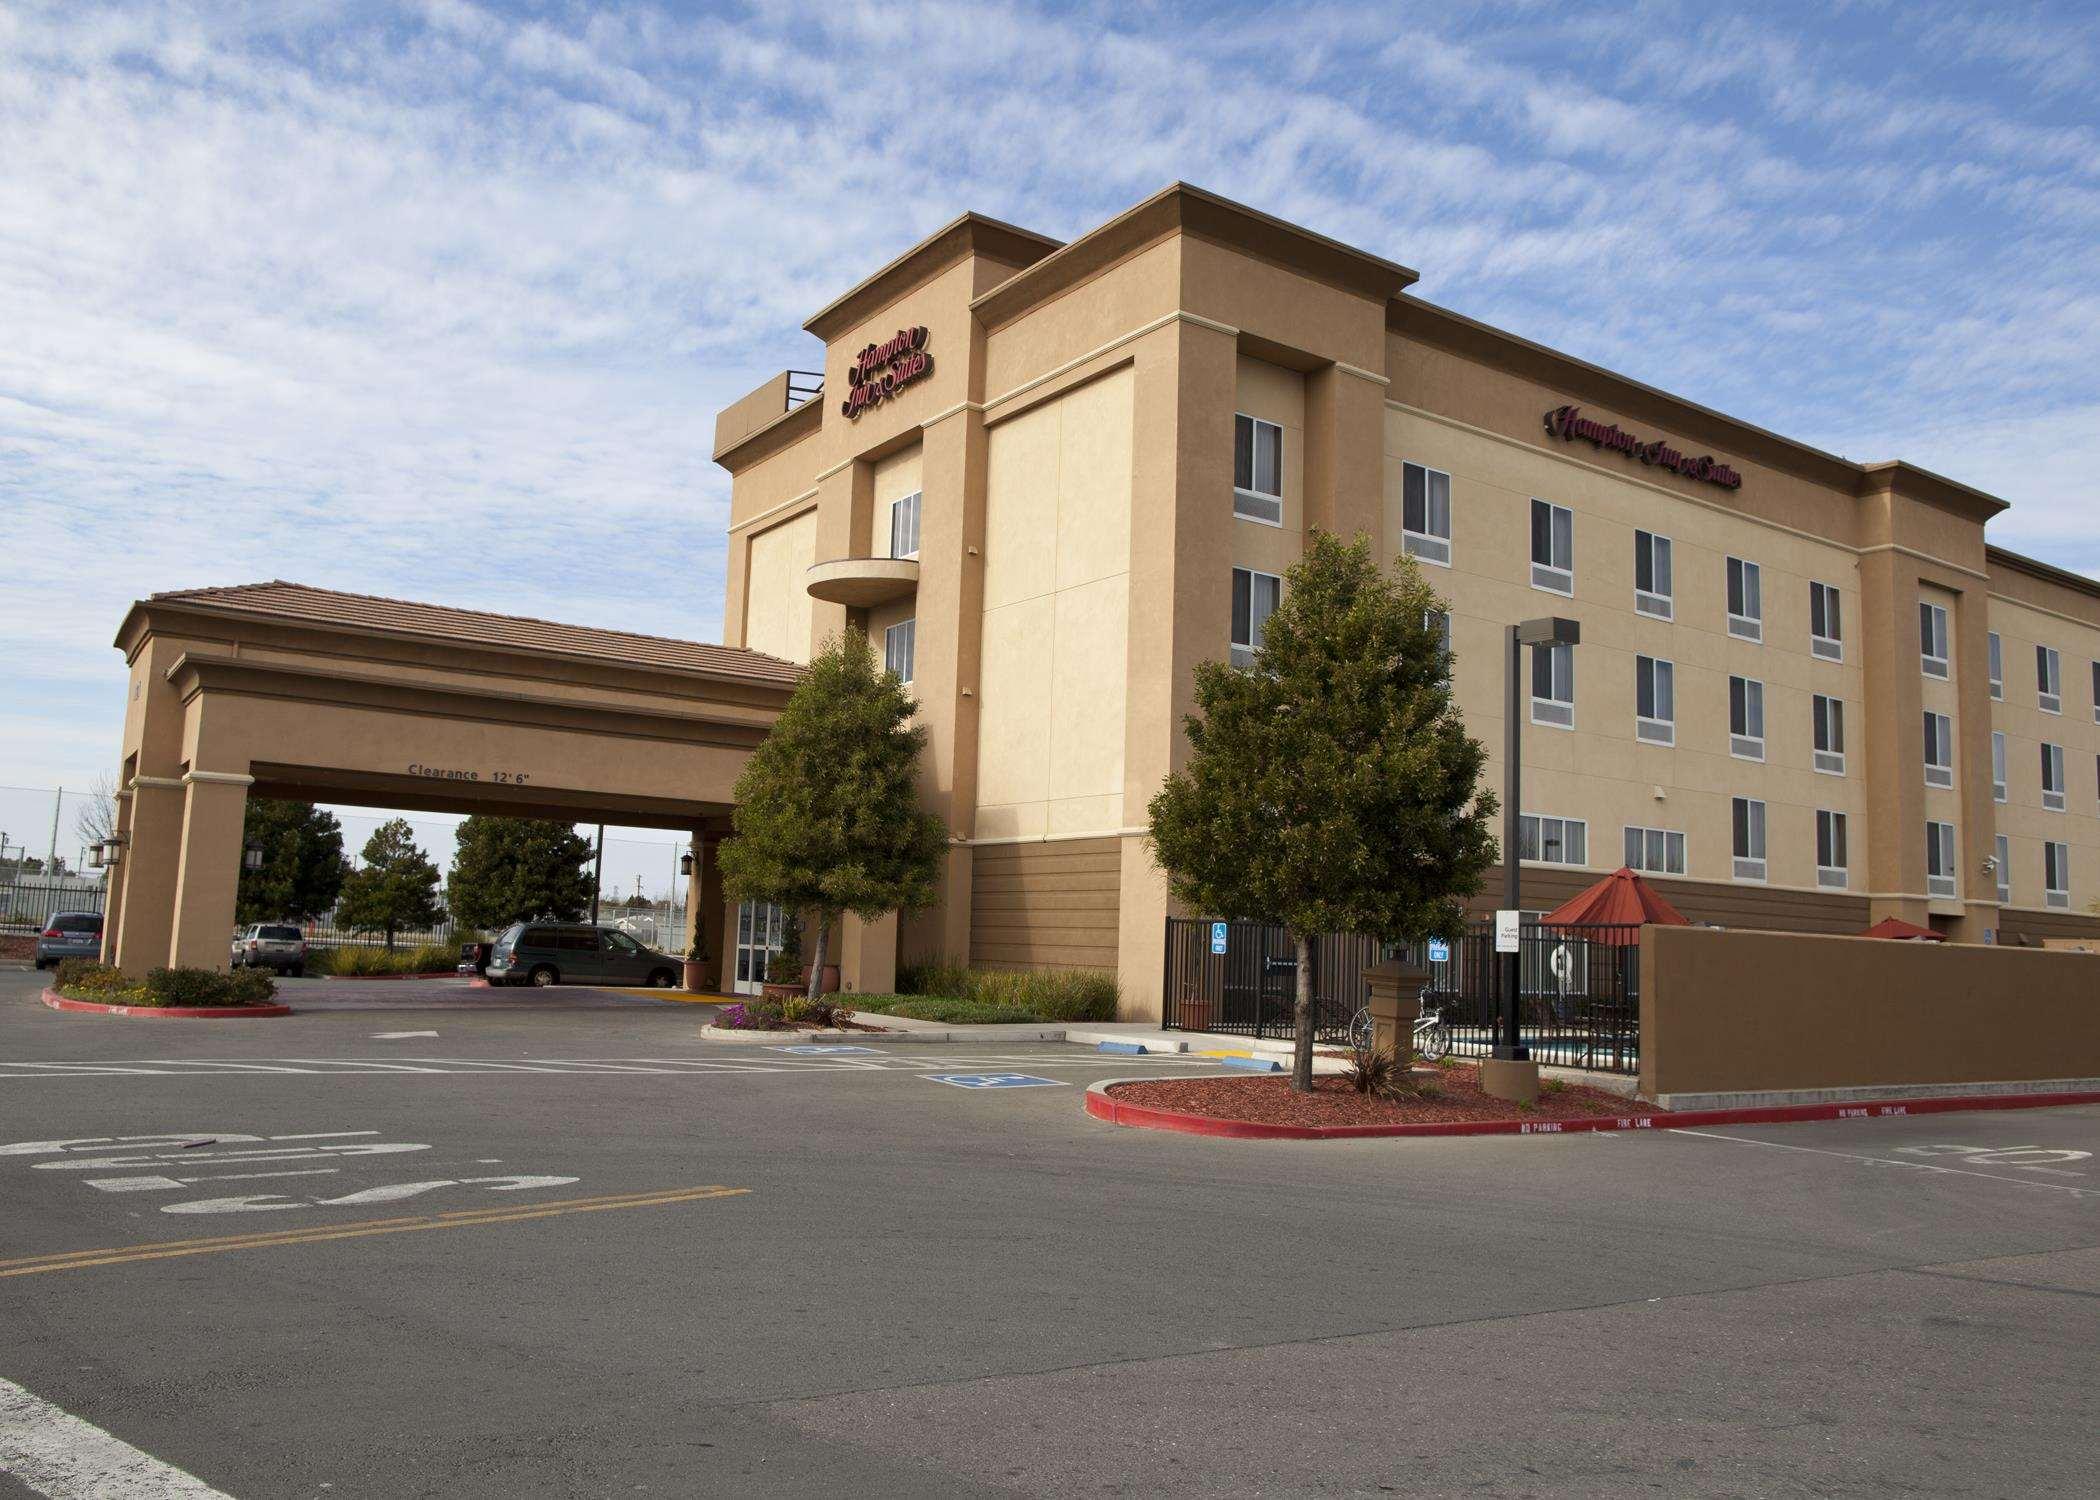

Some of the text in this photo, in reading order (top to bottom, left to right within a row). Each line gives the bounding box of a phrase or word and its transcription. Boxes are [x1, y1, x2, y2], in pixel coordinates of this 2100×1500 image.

[848, 326, 930, 387] Hampton
[885, 352, 935, 393] Suites
[1543, 405, 1645, 458] Hampton
[408, 763, 478, 781] Clearance
[1521, 1123, 1531, 1133] NO
[1533, 1122, 1562, 1132] PARKING
